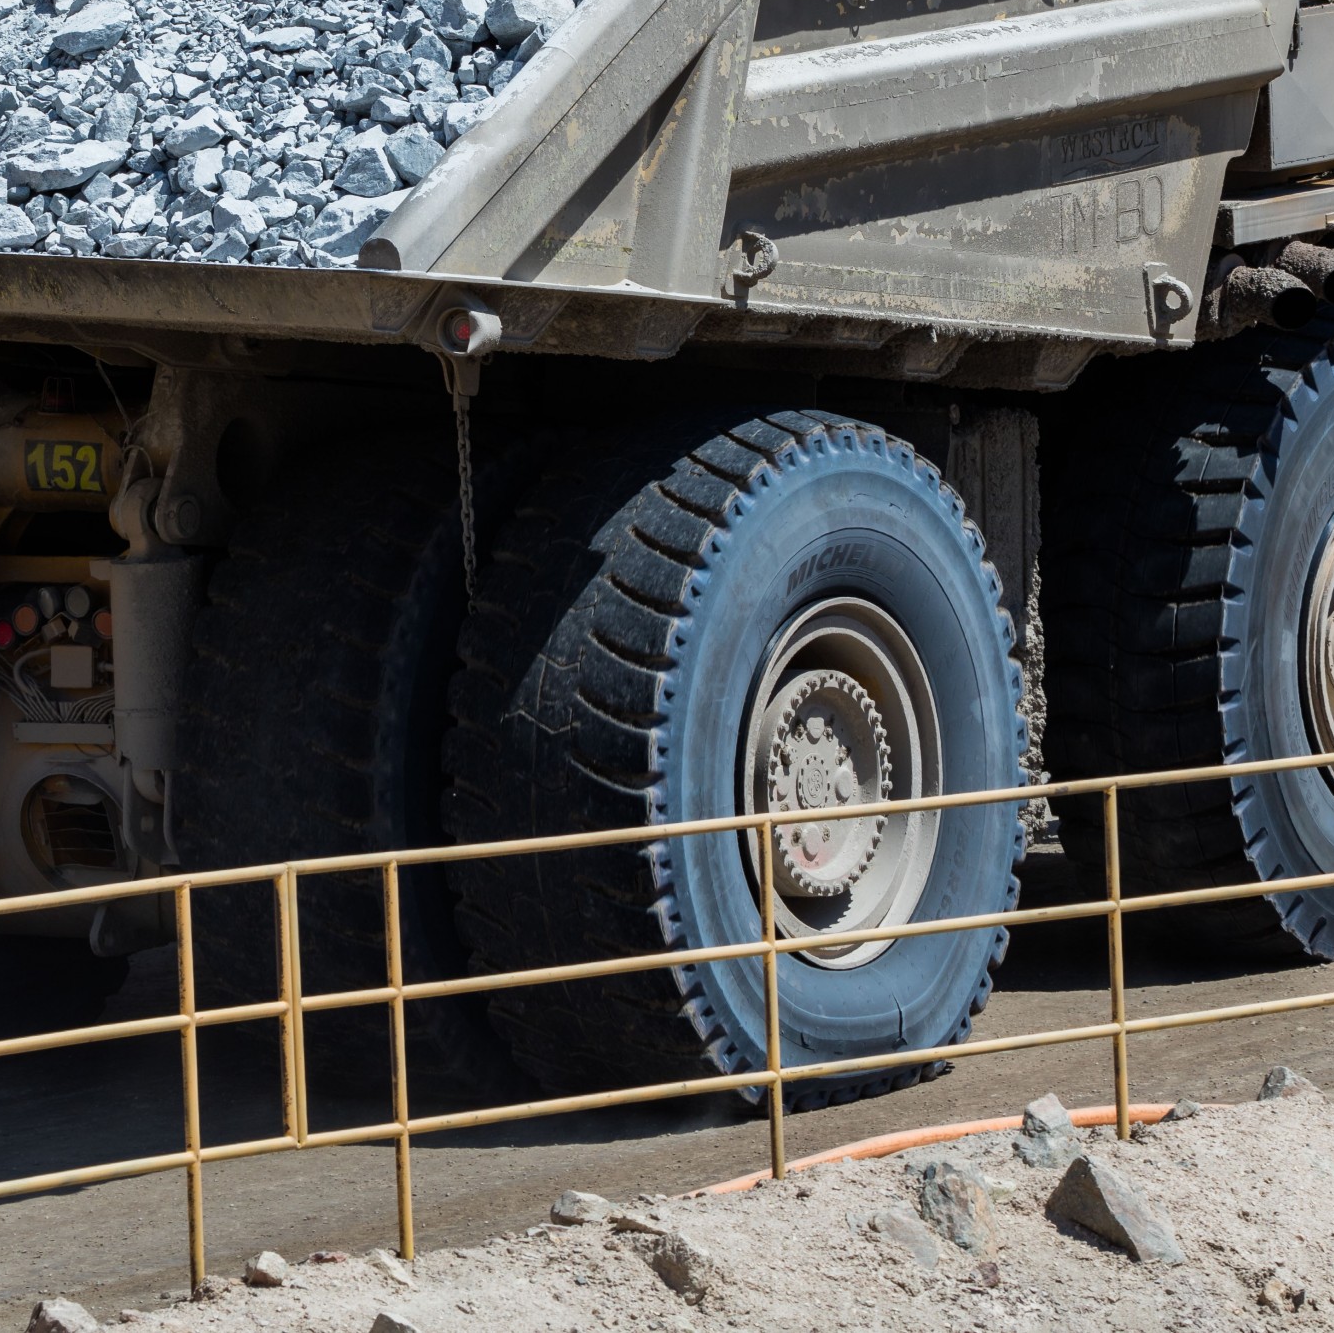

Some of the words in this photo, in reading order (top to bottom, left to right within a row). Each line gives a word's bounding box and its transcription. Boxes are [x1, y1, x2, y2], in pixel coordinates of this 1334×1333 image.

[1058, 119, 1159, 164] WESTECH
[27, 443, 102, 491] 152
[786, 542, 906, 598] MICHEL
